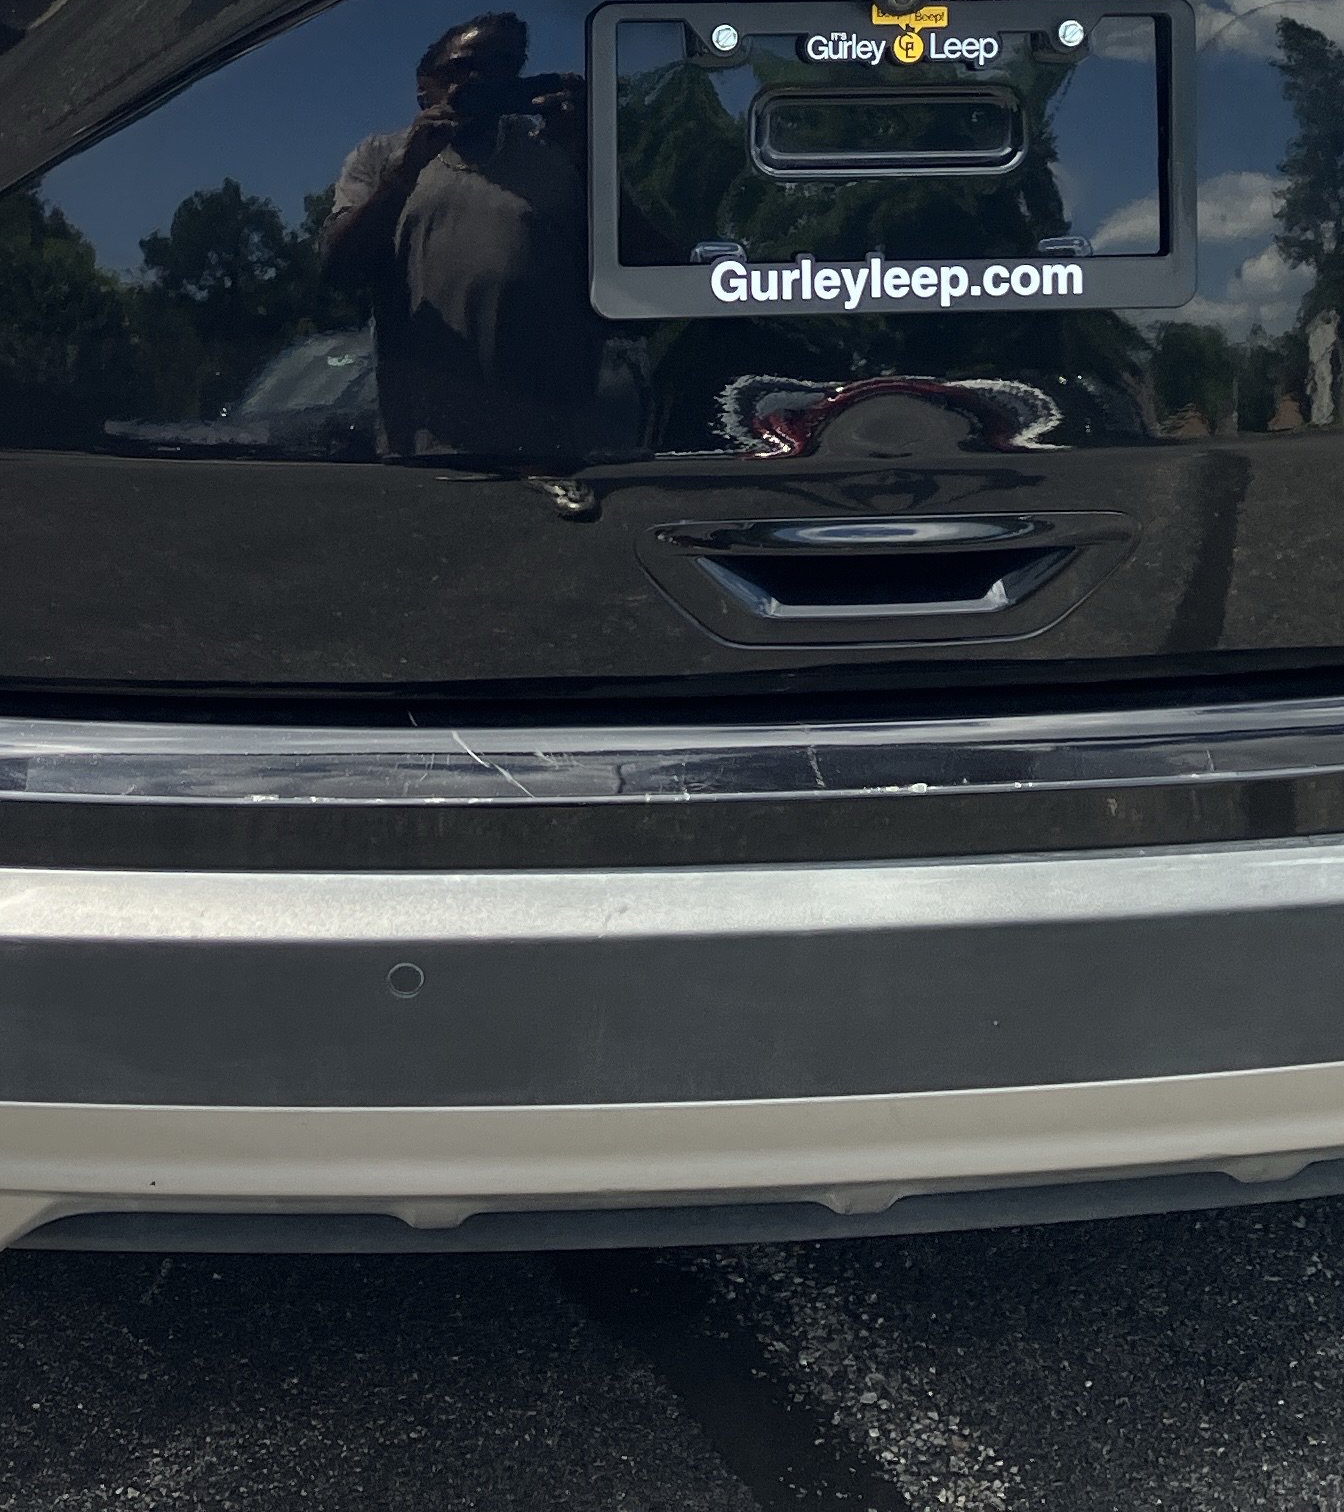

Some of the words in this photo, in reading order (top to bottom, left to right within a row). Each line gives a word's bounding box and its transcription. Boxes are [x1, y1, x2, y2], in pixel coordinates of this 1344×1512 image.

[914, 11, 945, 24] Beep!
[807, 33, 886, 66] Gurley
[930, 33, 999, 66] Leep
[710, 258, 1084, 310] Gurleyleep.com
